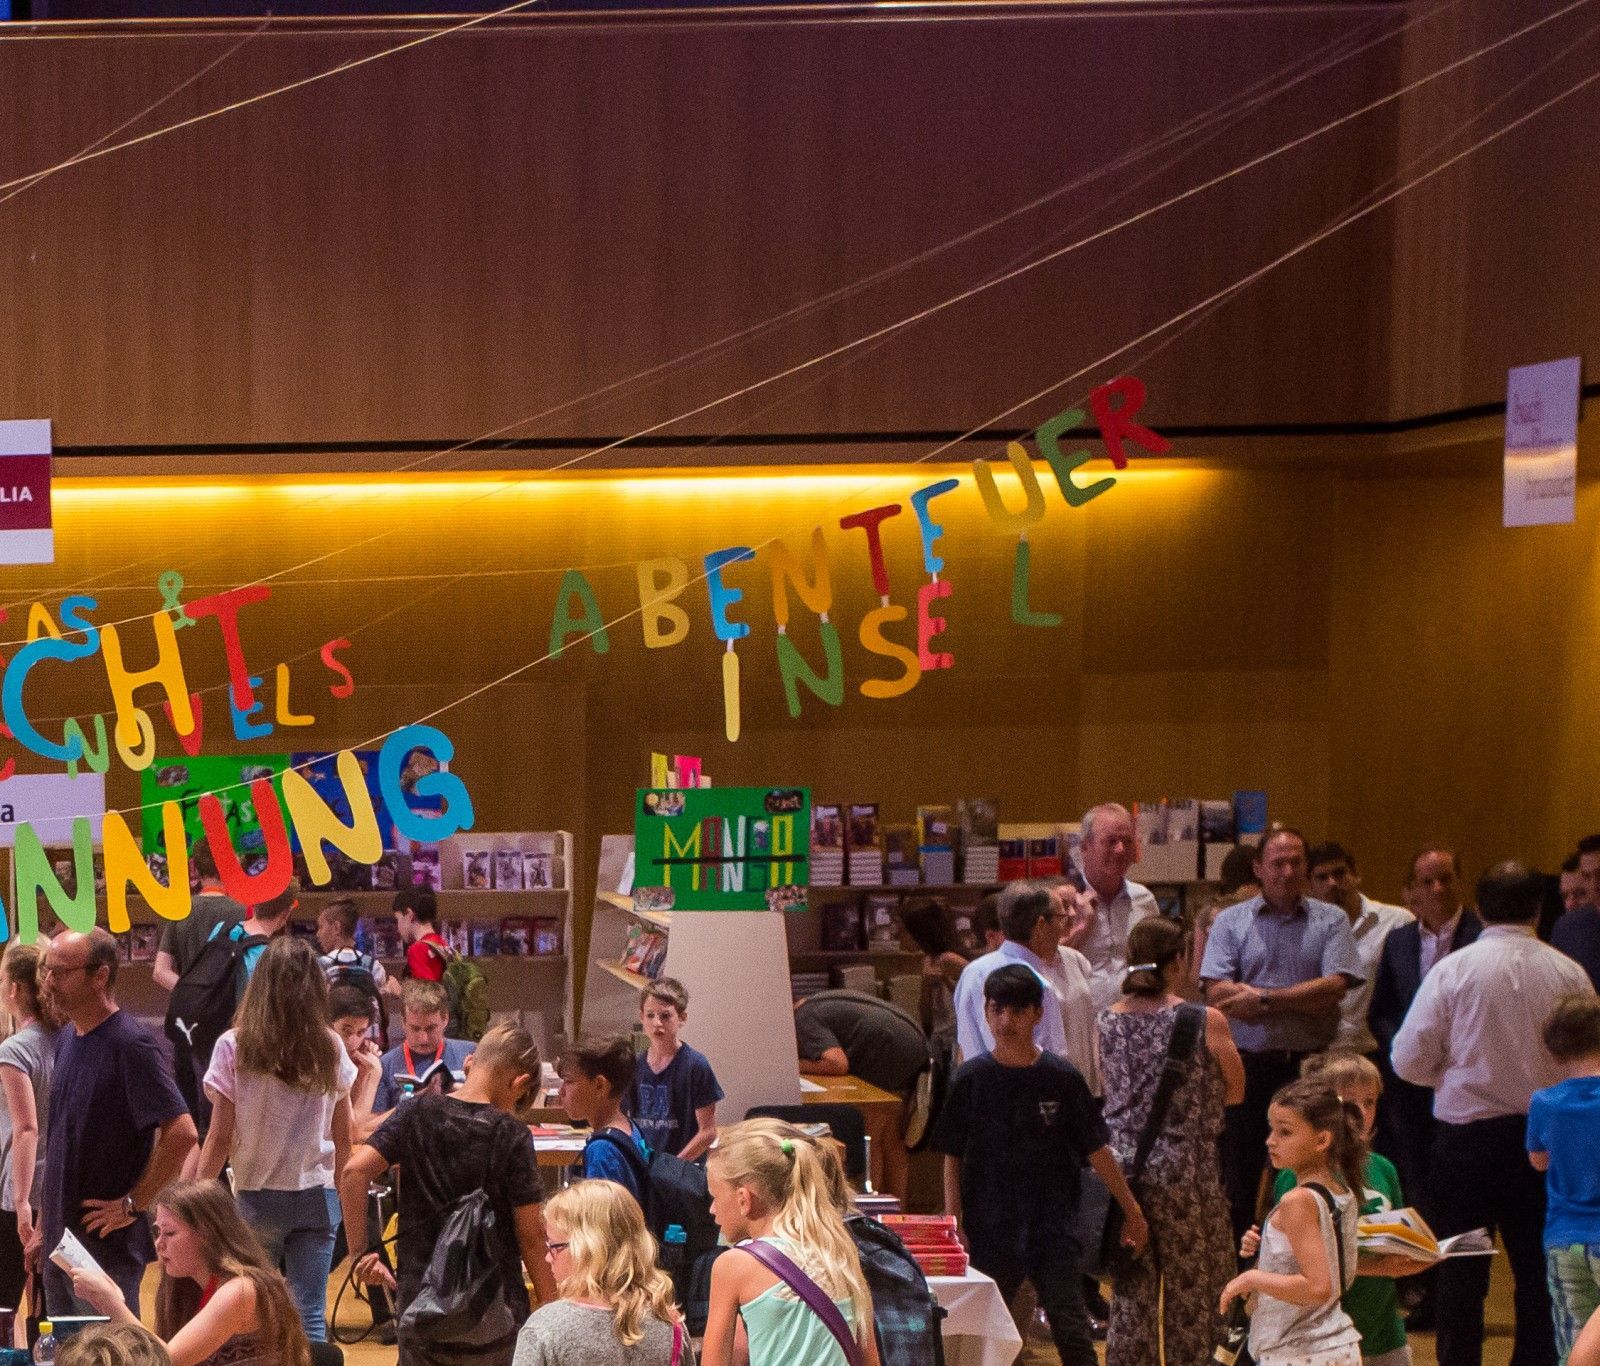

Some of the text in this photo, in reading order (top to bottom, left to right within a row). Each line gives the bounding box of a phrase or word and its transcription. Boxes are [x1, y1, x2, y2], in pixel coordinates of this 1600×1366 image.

[548, 375, 1171, 659] ABENTEUER
[722, 542, 1064, 743] INSEL
[663, 814, 794, 892] MANGA
